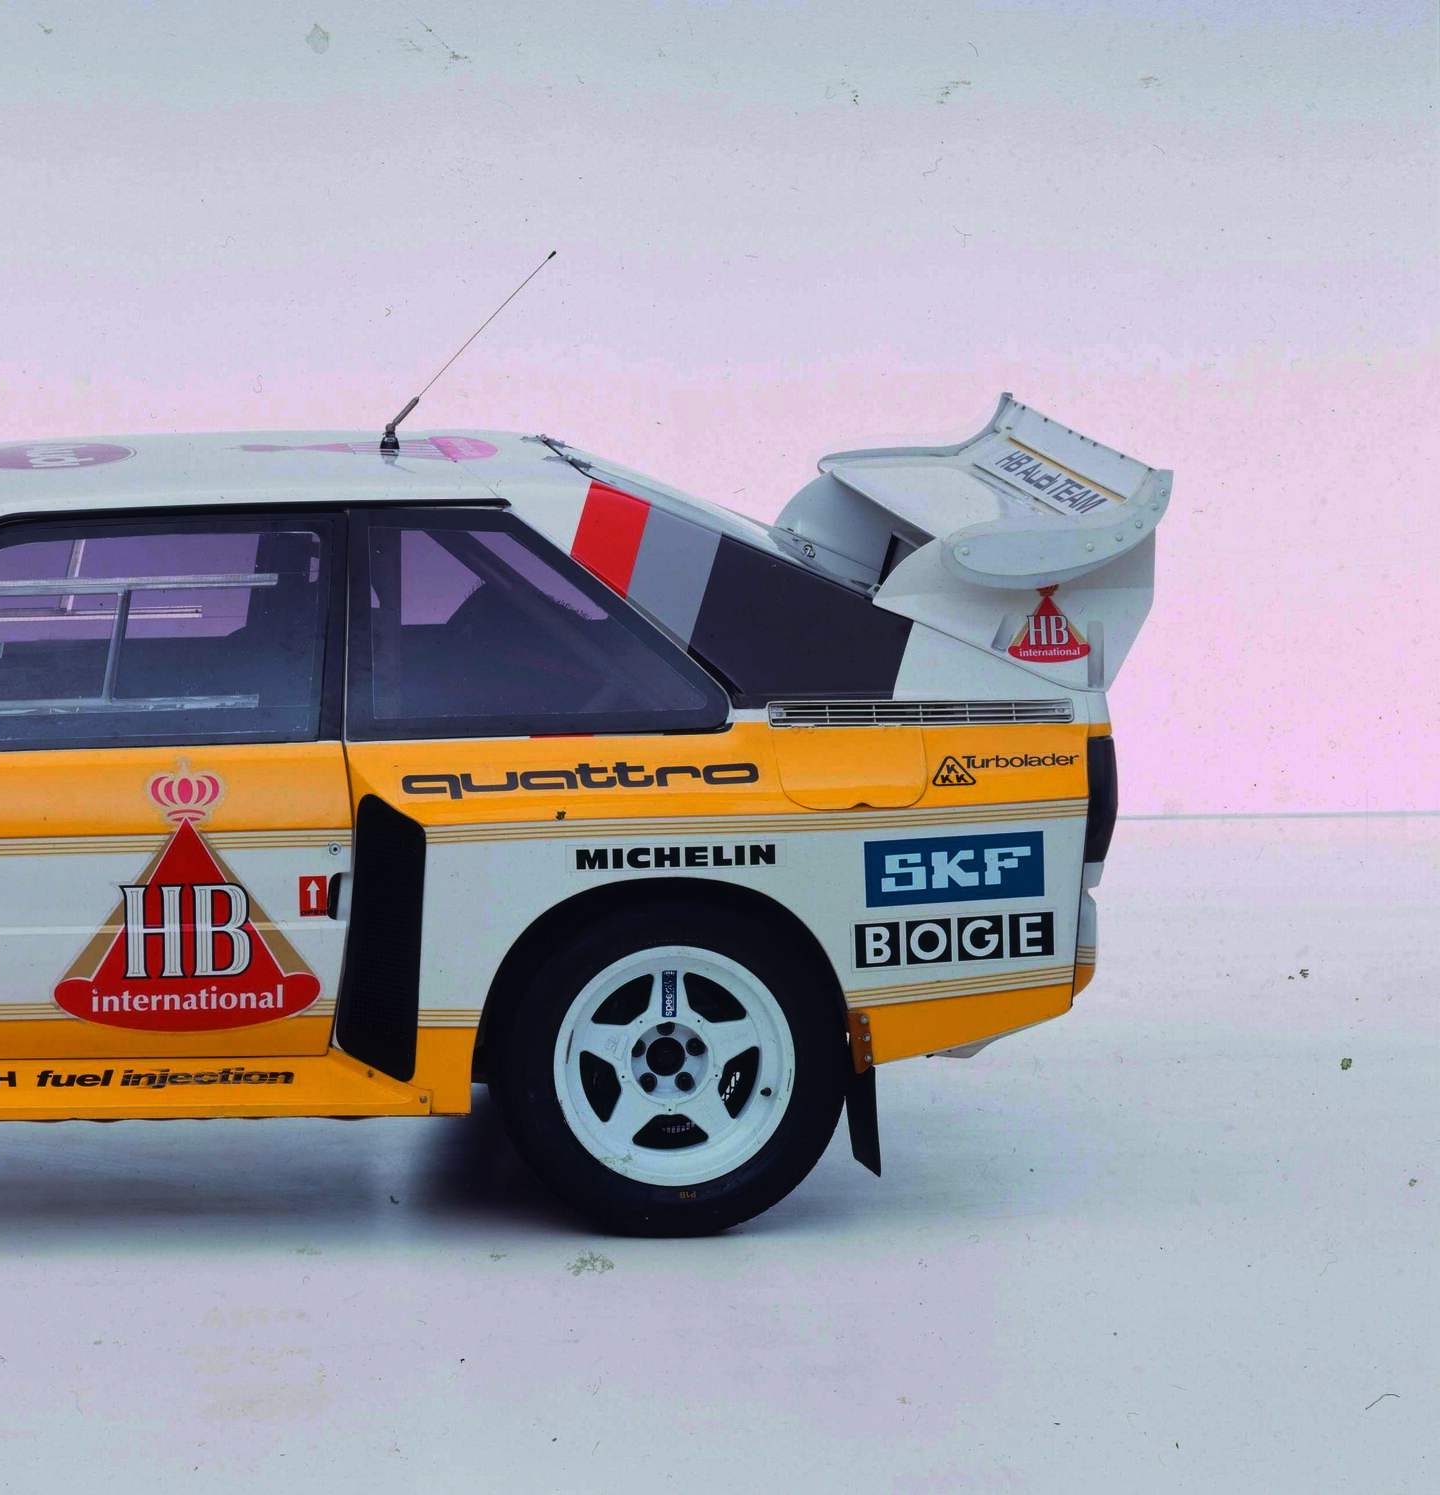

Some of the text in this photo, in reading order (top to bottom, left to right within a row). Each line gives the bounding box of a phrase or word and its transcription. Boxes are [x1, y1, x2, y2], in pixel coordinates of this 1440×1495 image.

[995, 450, 1108, 514] HB Audi TEAM
[1027, 614, 1069, 646] HB
[1019, 647, 1080, 657] international
[962, 753, 1079, 769] Turbolader
[401, 761, 760, 800] quattro
[575, 844, 777, 870] MICHELIN
[880, 845, 1032, 893] SKF
[119, 882, 253, 979] HB
[864, 915, 1043, 964] BOGE
[91, 985, 284, 1013] international
[36, 1069, 114, 1088] fuel
[119, 1067, 295, 1089] injection
